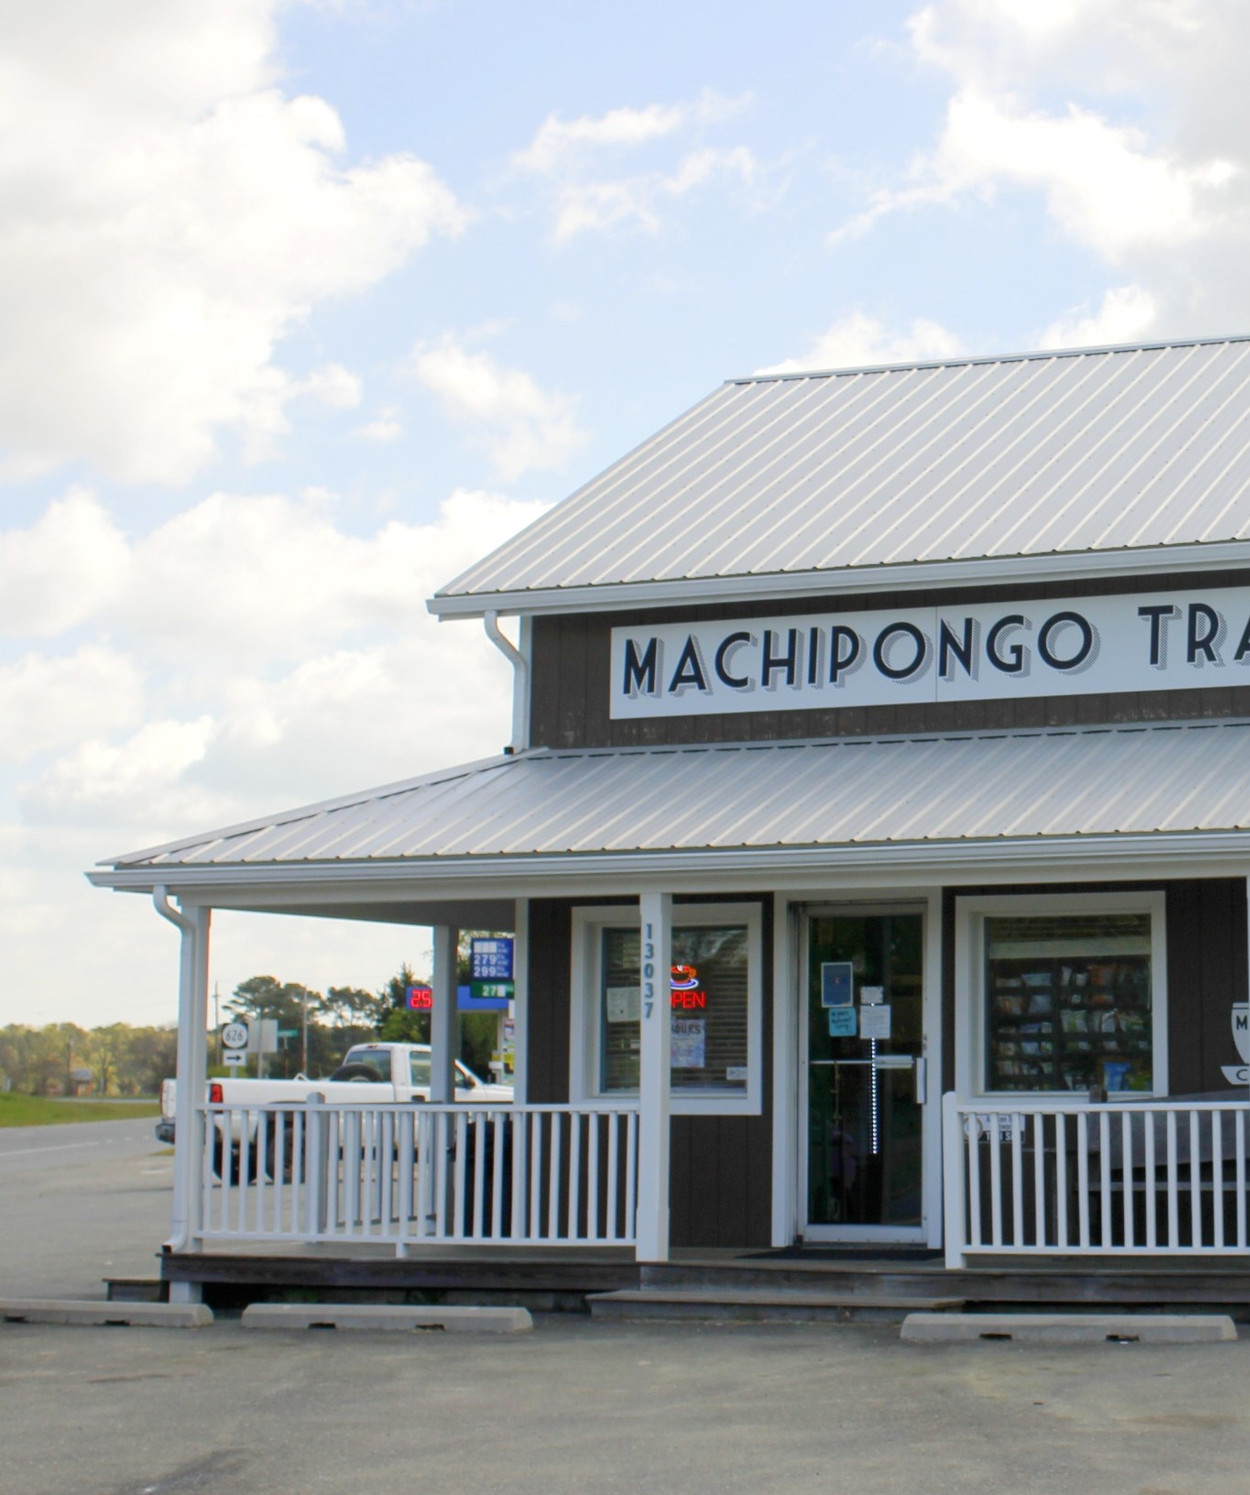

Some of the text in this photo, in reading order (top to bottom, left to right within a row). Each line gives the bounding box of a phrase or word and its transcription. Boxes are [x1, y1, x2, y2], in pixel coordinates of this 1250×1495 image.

[622, 611, 1099, 699] MACHIPONGO
[473, 954, 497, 966] 279
[473, 966, 497, 978] 299
[644, 923, 655, 1019] 13037
[226, 1029, 243, 1042] 626
